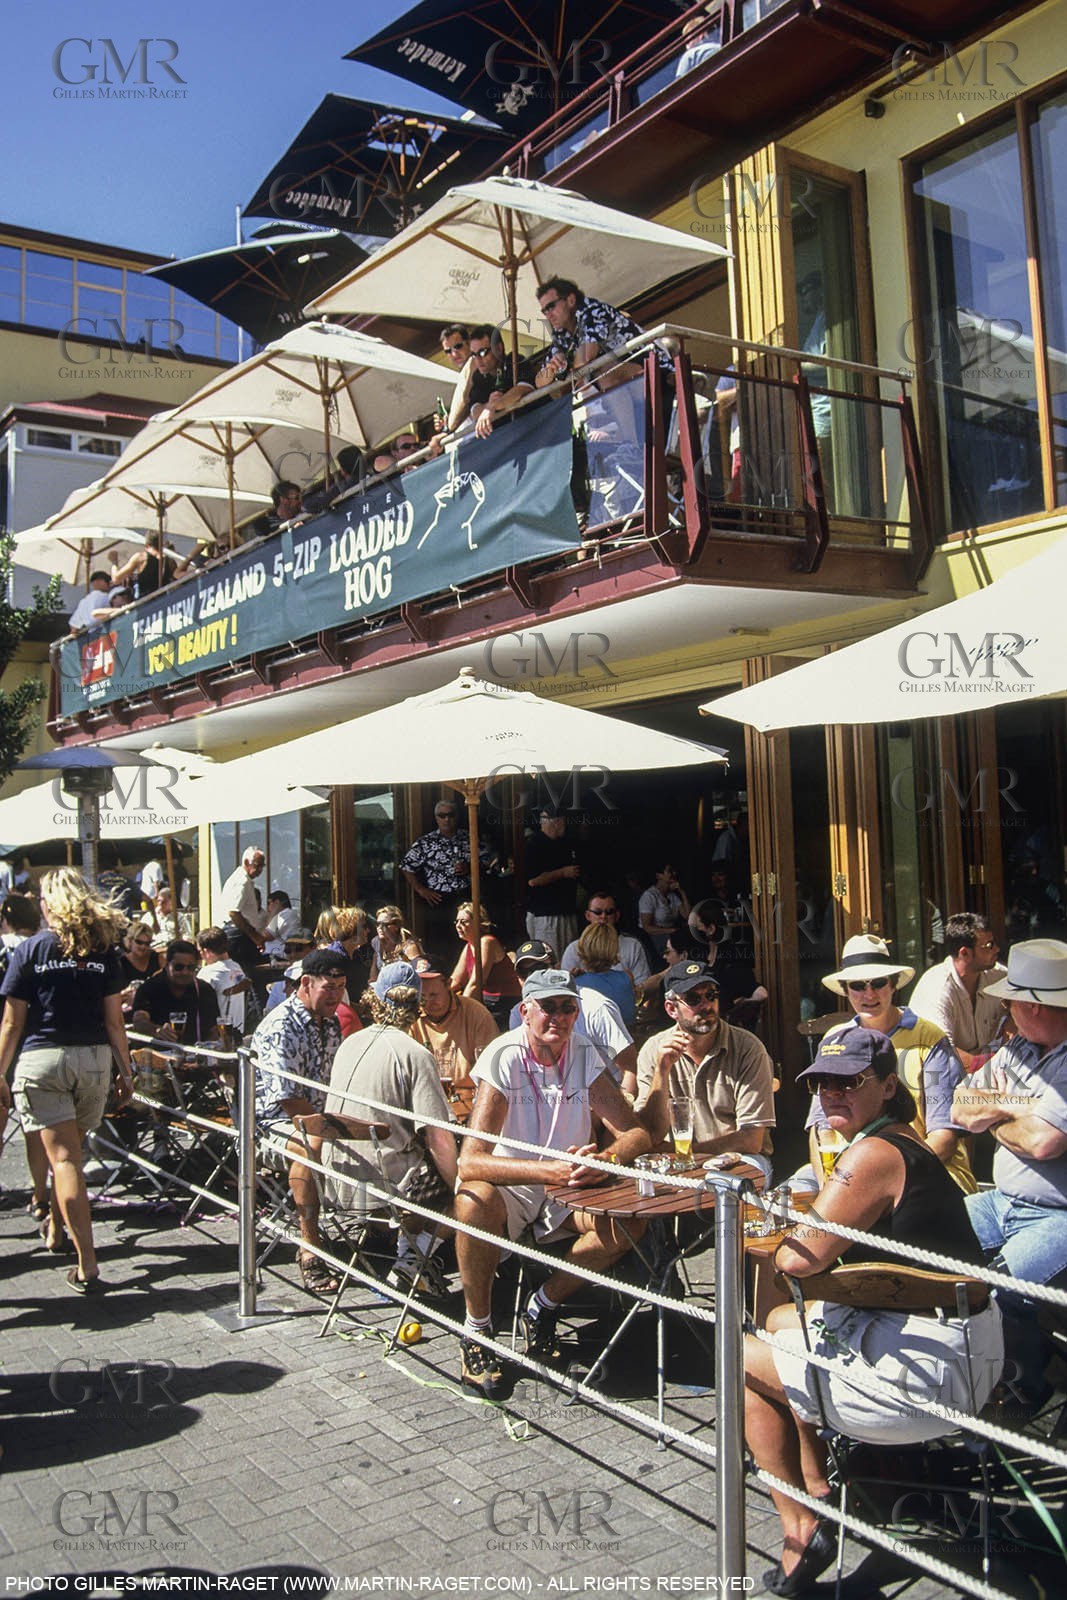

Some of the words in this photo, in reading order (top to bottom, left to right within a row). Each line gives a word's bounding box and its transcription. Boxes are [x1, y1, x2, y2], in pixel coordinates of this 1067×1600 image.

[397, 37, 467, 83] Kermadec
[346, 492, 392, 521] THE
[329, 499, 414, 574] LOADED
[132, 610, 163, 648] TEAM
[166, 594, 196, 634] NEW
[199, 562, 266, 619] ZEALAND
[272, 536, 322, 587] 5-ZIP
[343, 555, 393, 611] HOG
